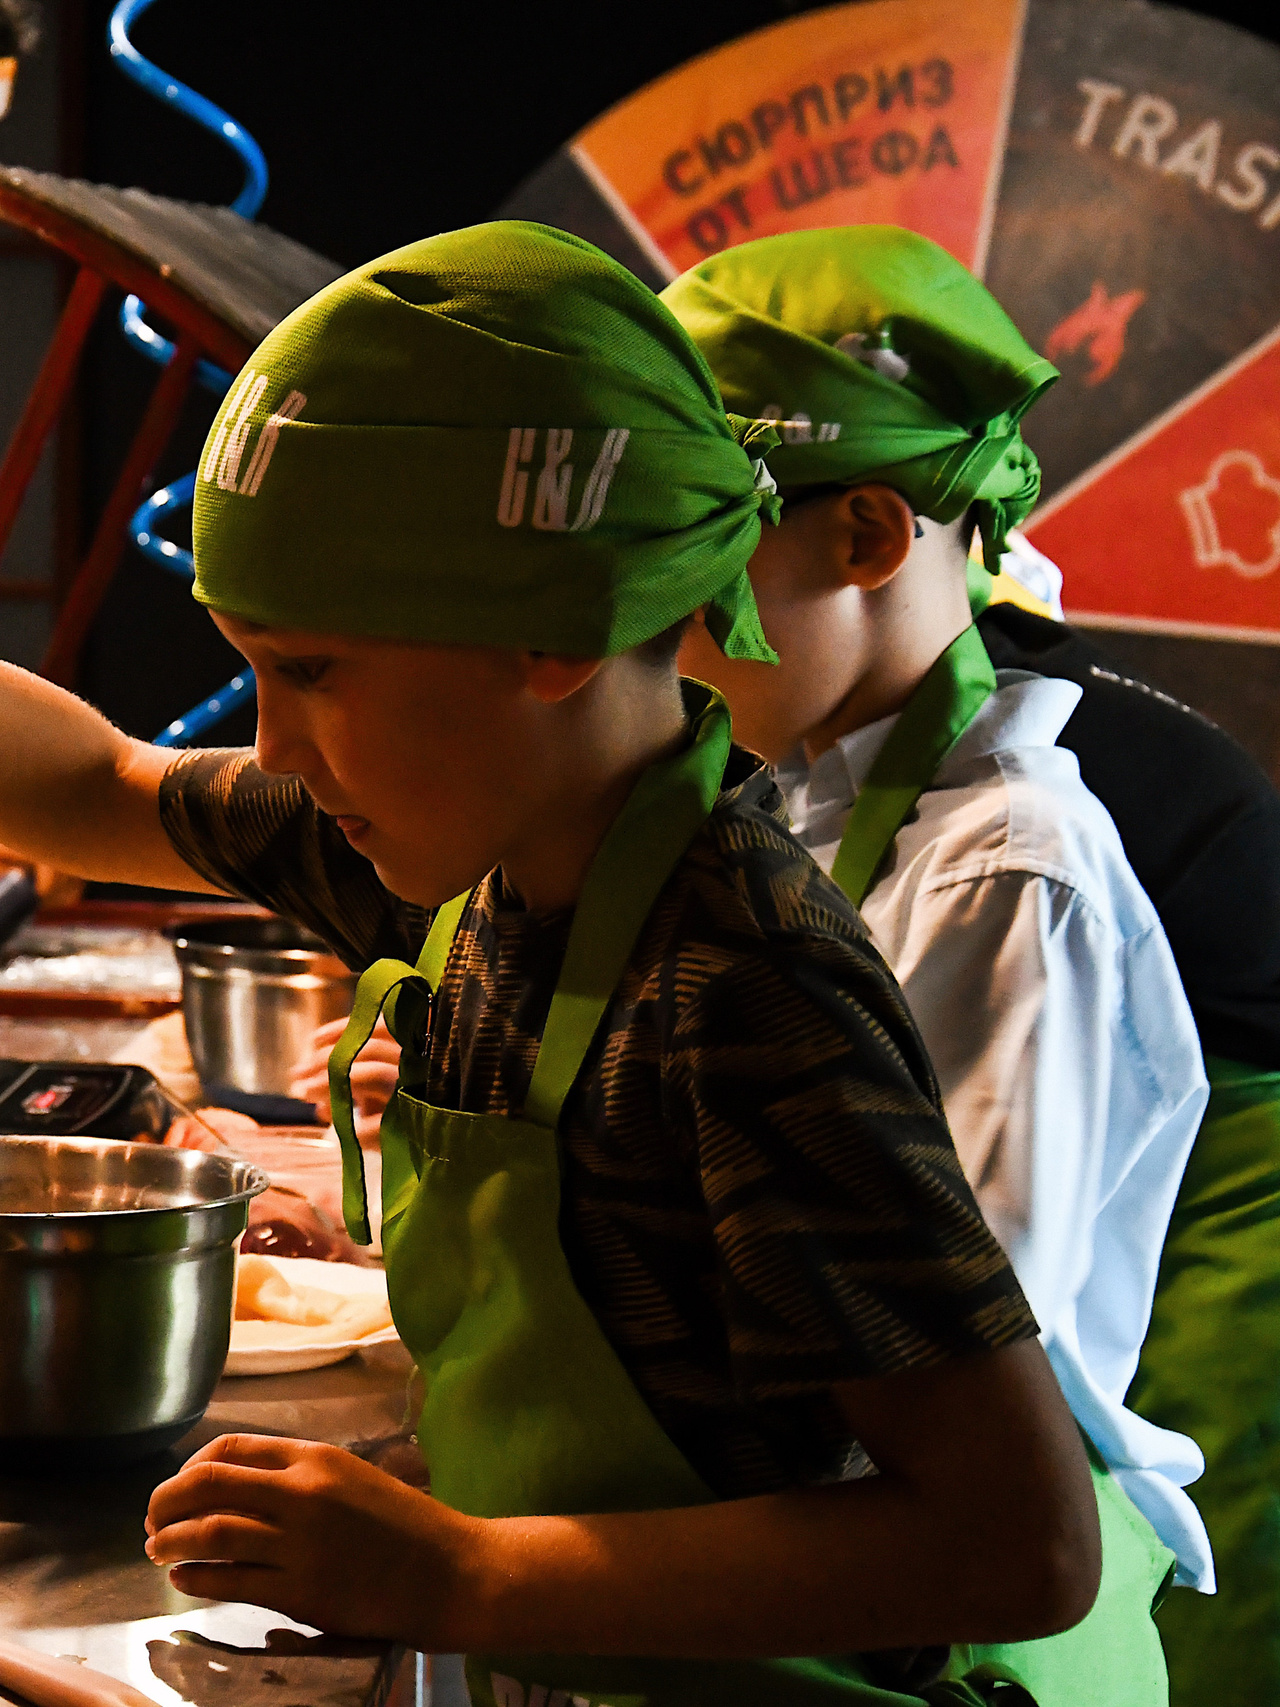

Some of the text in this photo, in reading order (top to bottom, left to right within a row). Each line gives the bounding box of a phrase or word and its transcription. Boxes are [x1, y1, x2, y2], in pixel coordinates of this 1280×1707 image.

[662, 58, 955, 197] СЮРПРИЗ
[686, 123, 959, 255] ОТ ШЕФА
[1074, 78, 1280, 232] TRAS
